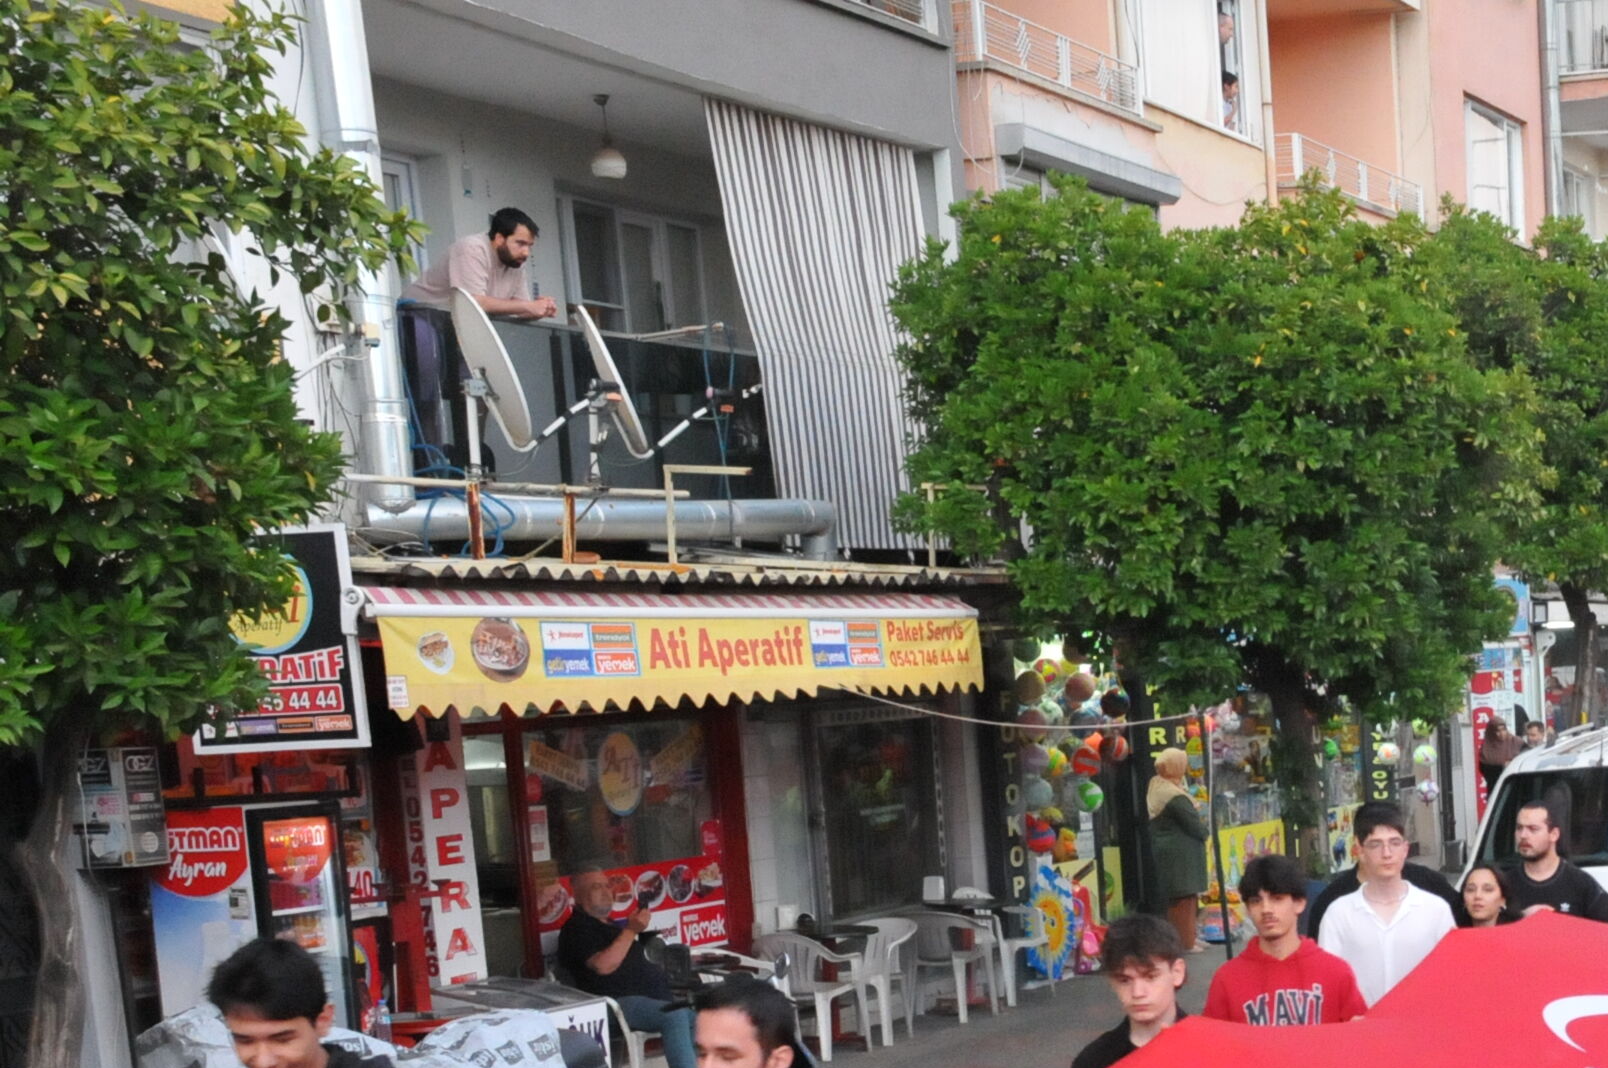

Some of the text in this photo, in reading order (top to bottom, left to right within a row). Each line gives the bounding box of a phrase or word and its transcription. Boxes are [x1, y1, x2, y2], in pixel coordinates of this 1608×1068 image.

[886, 619, 923, 643] Paket
[649, 625, 804, 676] Ati Aperatif
[889, 649, 917, 668] 0542
[918, 649, 938, 666] 746
[954, 648, 969, 664] 44
[289, 690, 310, 710] 44
[316, 689, 338, 708] 44
[1001, 690, 1026, 898] FOTOKOP
[168, 853, 227, 887] Ayran
[424, 740, 478, 984] APERA
[683, 913, 726, 946] yemek
